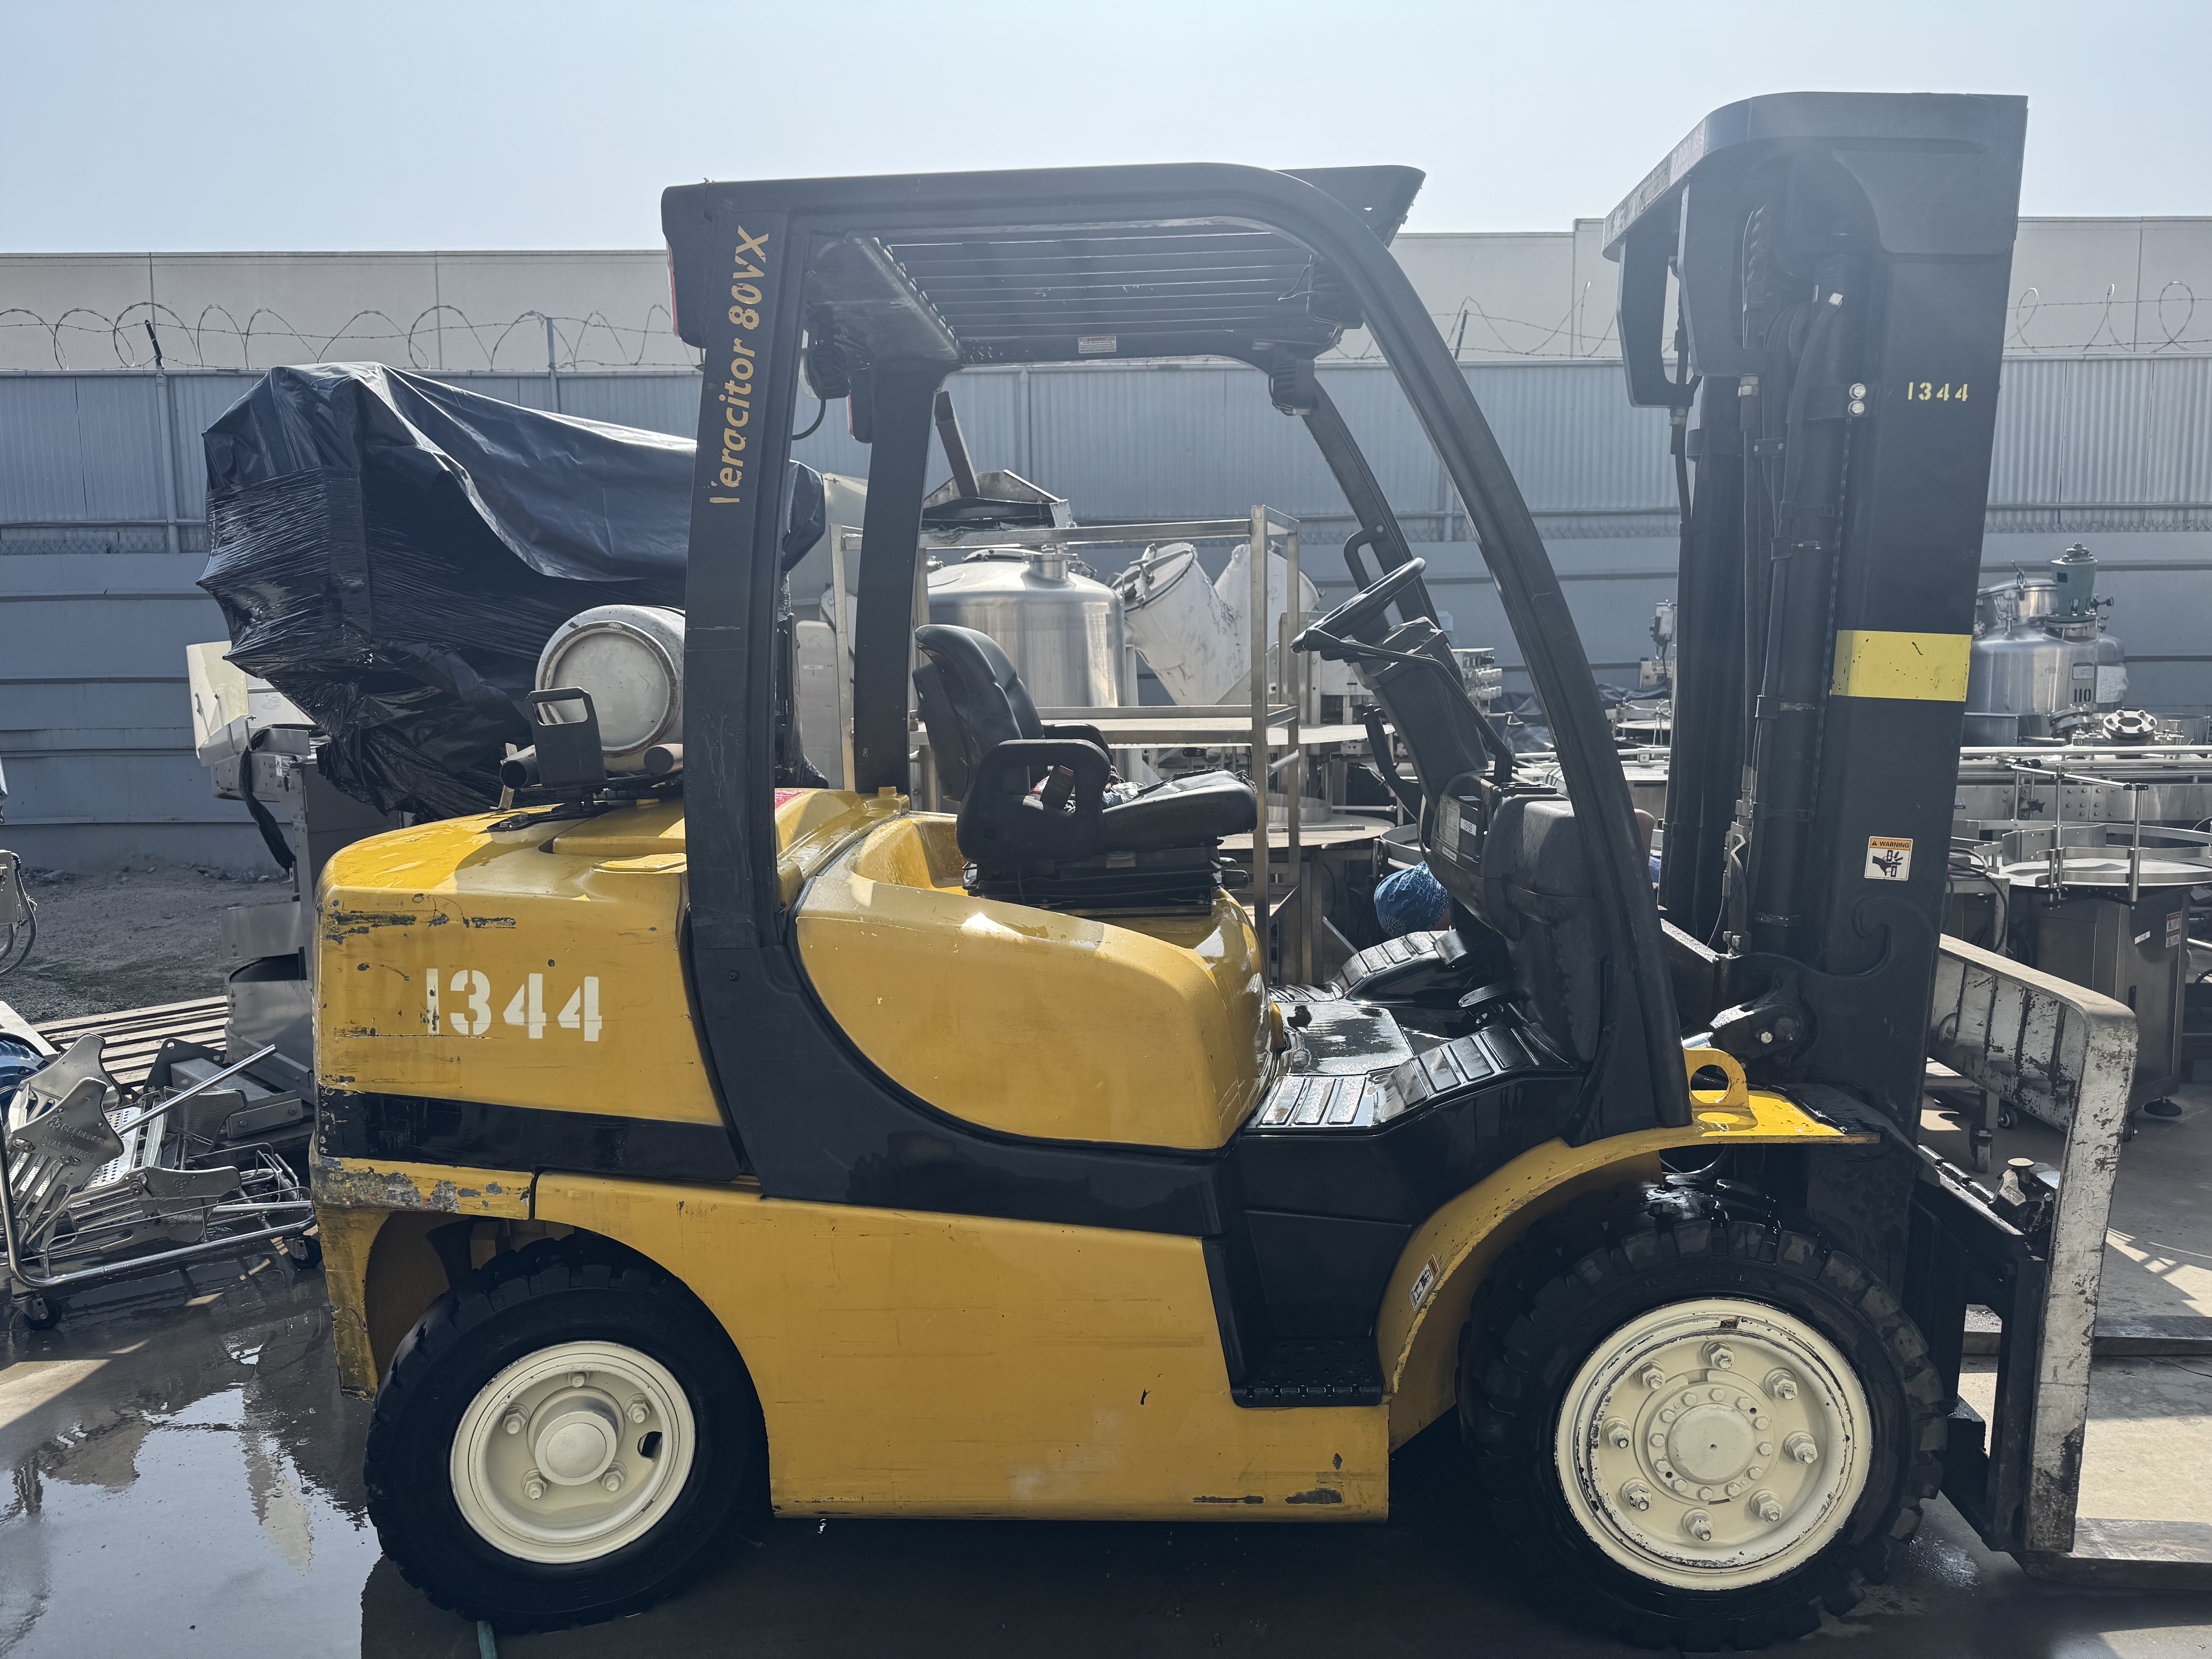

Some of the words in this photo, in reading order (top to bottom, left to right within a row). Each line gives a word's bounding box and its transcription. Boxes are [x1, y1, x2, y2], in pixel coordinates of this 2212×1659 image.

[728, 225, 769, 330] 80VX
[1908, 382, 1968, 402] 1344
[2074, 689, 2091, 702] 110
[426, 968, 602, 1042] 1344
